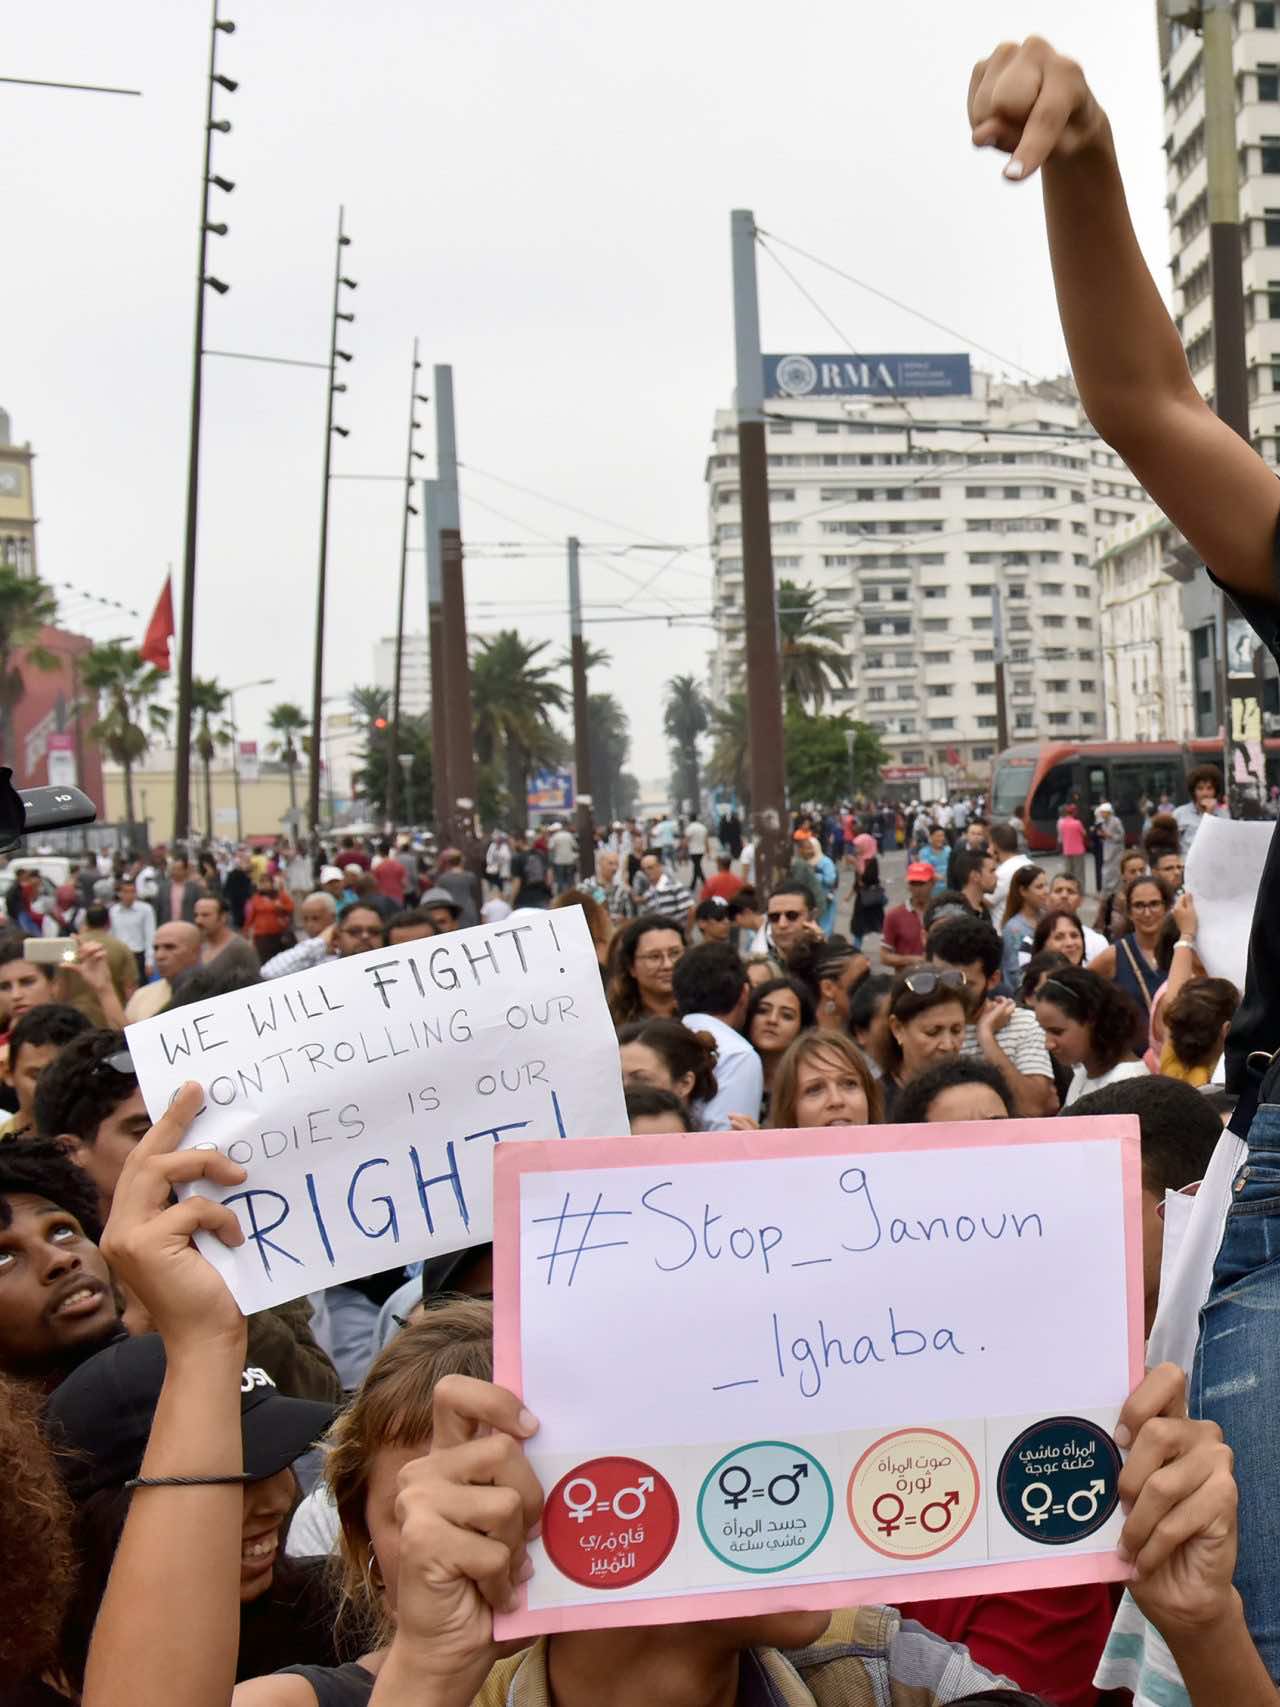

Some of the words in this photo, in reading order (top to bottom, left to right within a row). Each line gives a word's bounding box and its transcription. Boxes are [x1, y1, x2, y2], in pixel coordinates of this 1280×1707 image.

[821, 362, 896, 389] RMA
[505, 994, 580, 1031] OUR
[159, 1012, 229, 1066] WE
[247, 984, 344, 1037] WILL
[408, 1086, 441, 1114] IS
[475, 1059, 549, 1097] OUR
[1062, 1439, 1096, 1458] المرأة
[878, 1455, 913, 1474] المرأة
[915, 1455, 952, 1471] صوت
[895, 1469, 932, 1495] ثورة
[722, 1517, 762, 1538] المرأة
[767, 1517, 807, 1534] جسد
